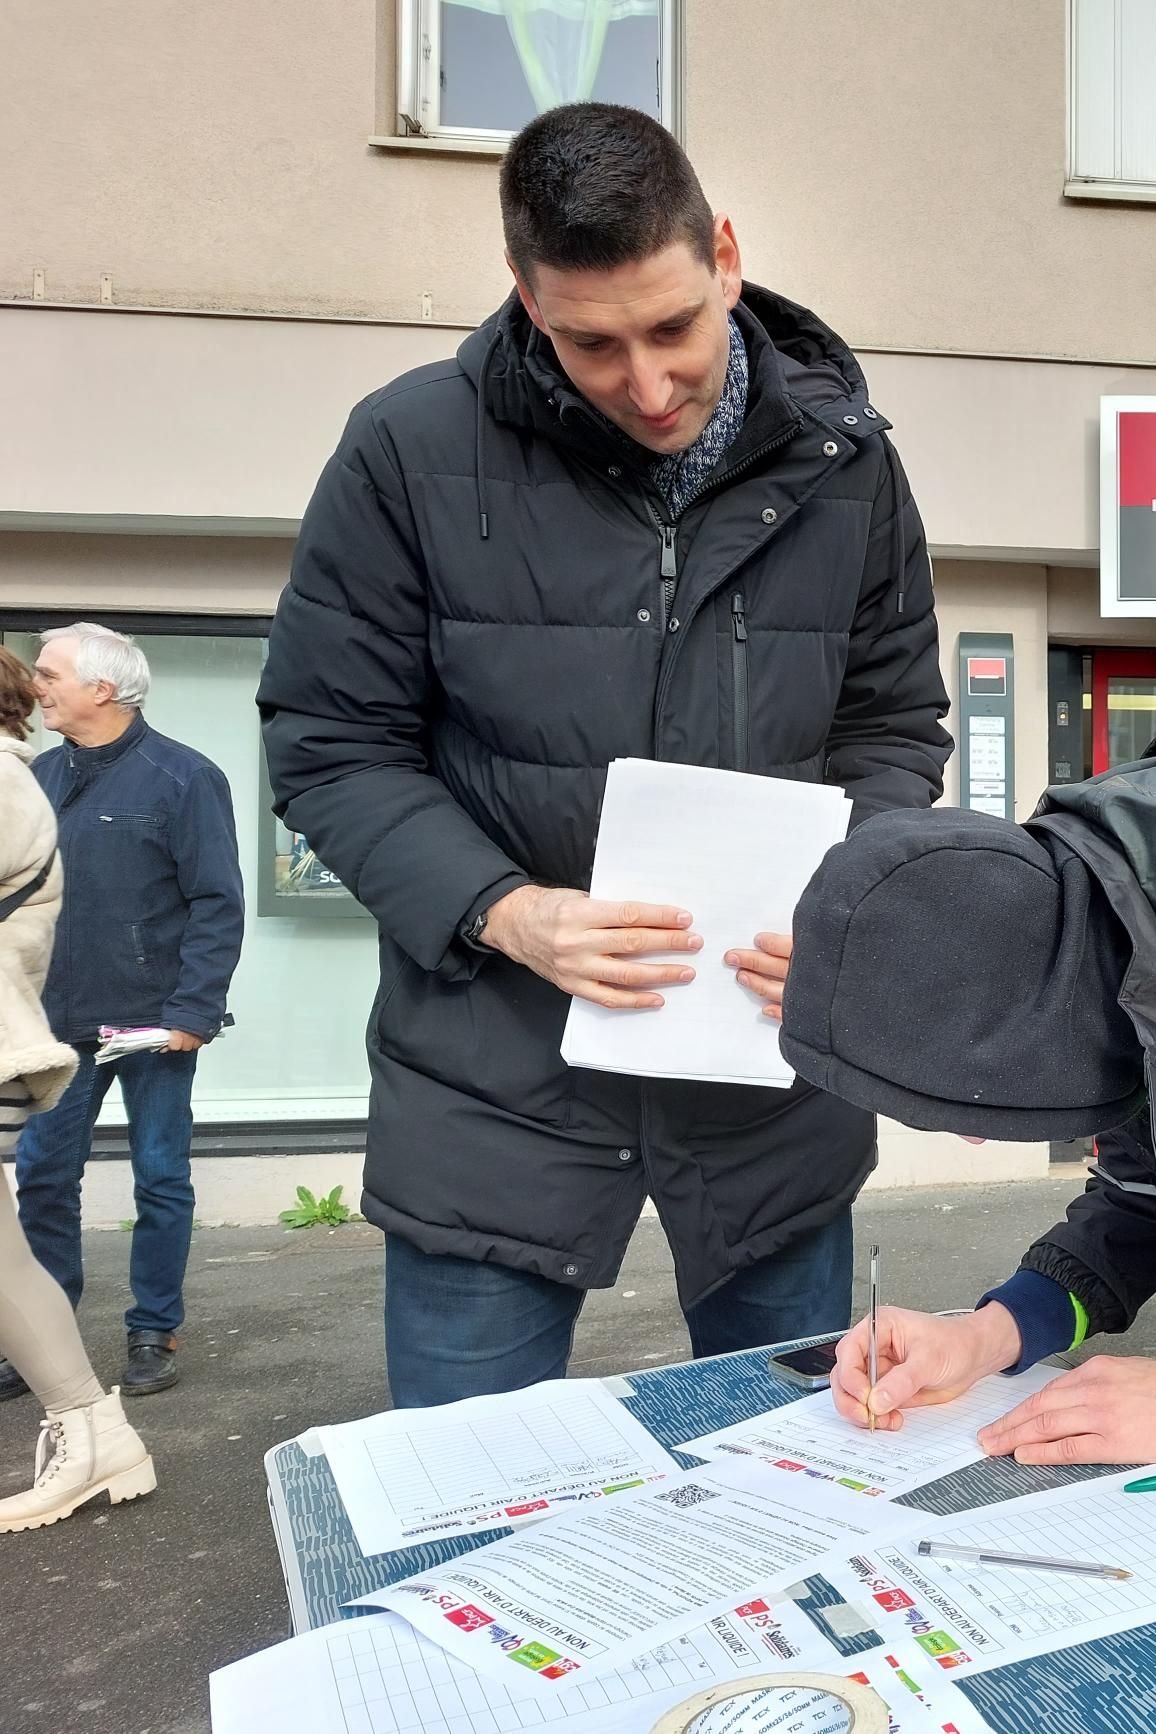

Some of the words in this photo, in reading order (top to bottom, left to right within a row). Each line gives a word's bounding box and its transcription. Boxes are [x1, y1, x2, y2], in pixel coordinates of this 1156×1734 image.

[611, 1471, 639, 1482] NON
[852, 1468, 866, 1477] AU
[866, 1472, 889, 1483] NON
[588, 1478, 606, 1487] AU
[488, 1494, 528, 1507] D'AIR
[430, 1502, 487, 1519] LIQUIDE
[891, 1557, 919, 1581] LIQUIDE
[446, 1573, 488, 1592] LIQUIDE
[867, 1579, 891, 1591] PS
[912, 1579, 936, 1596] D'AIR
[432, 1595, 460, 1610] PS
[483, 1590, 513, 1610] D'AIR
[929, 1594, 962, 1624] DÉPART
[508, 1606, 552, 1629] DÉPART
[750, 1614, 774, 1628] PS
[957, 1619, 972, 1630] AU
[547, 1626, 569, 1637] AU
[966, 1629, 989, 1646] NON
[562, 1633, 590, 1650] NON
[718, 1628, 747, 1654] LIQUIDE
